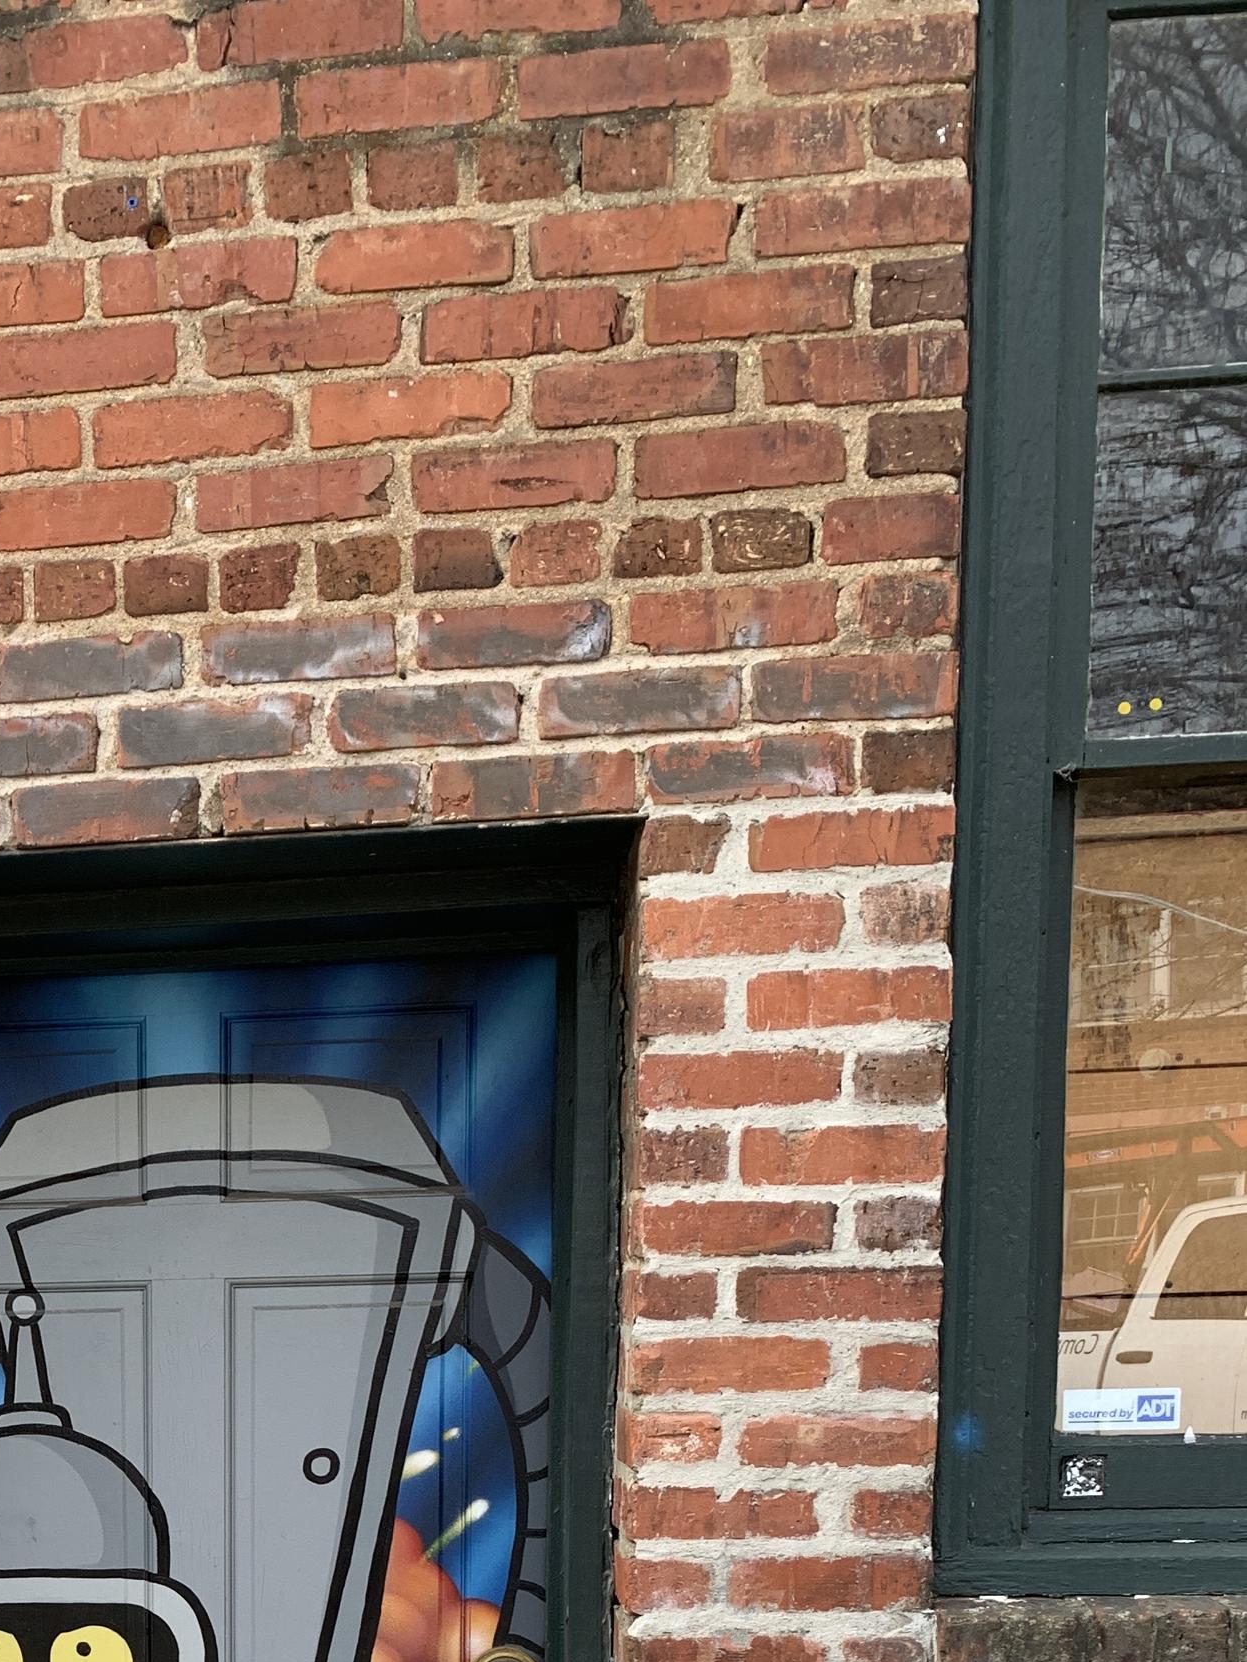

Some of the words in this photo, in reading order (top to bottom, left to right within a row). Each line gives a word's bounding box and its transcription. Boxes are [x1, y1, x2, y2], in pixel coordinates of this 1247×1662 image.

[1068, 1408, 1117, 1419] secured
[1119, 1408, 1134, 1419] by
[1136, 1398, 1175, 1418] ADT
